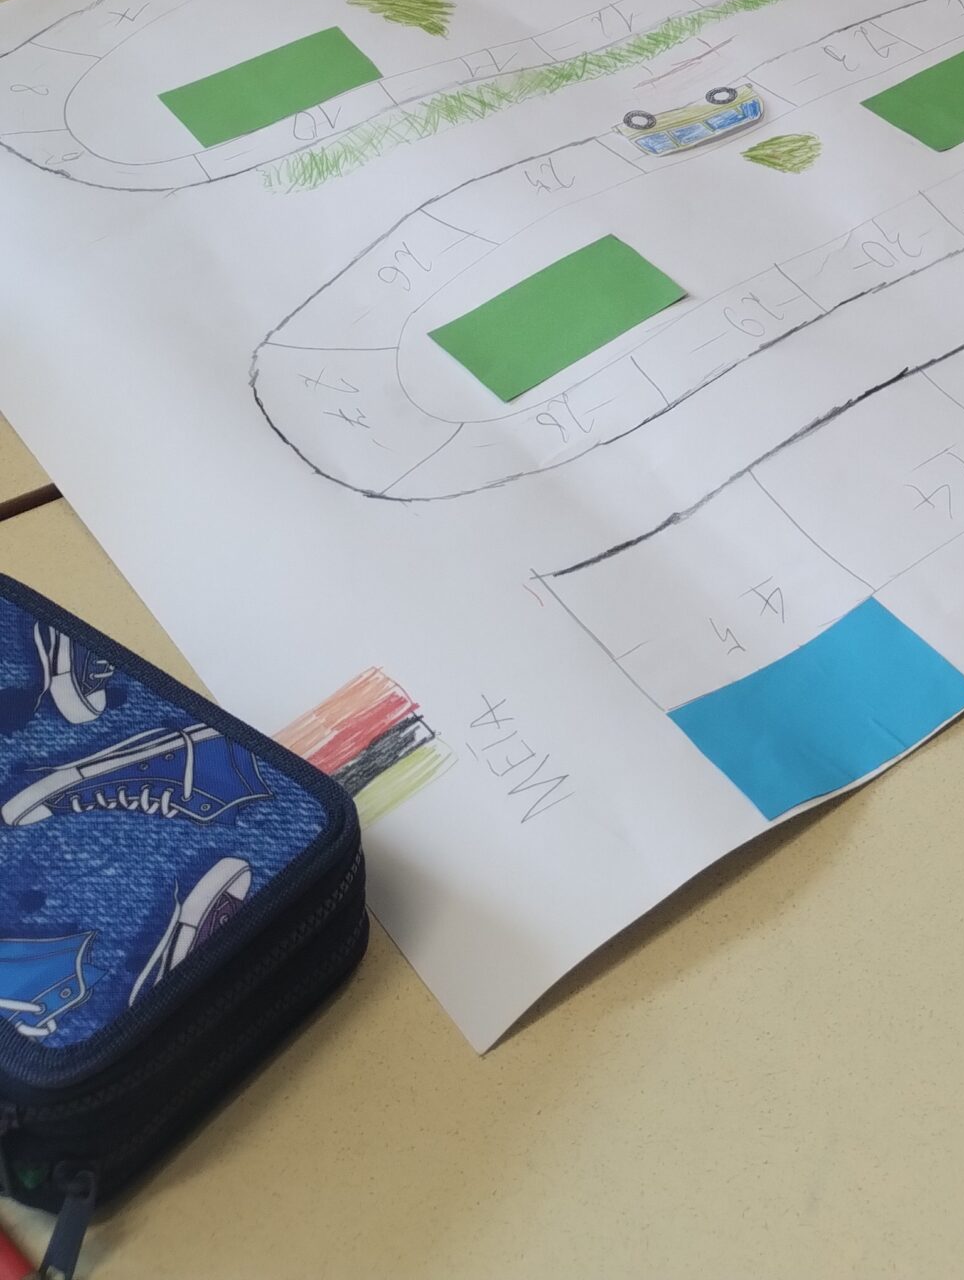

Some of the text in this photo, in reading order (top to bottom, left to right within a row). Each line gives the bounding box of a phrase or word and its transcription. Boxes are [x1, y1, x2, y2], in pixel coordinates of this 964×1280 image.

[293, 104, 342, 141] 10
[377, 241, 433, 292] 26
[535, 392, 595, 444] 28
[708, 582, 785, 656] 45
